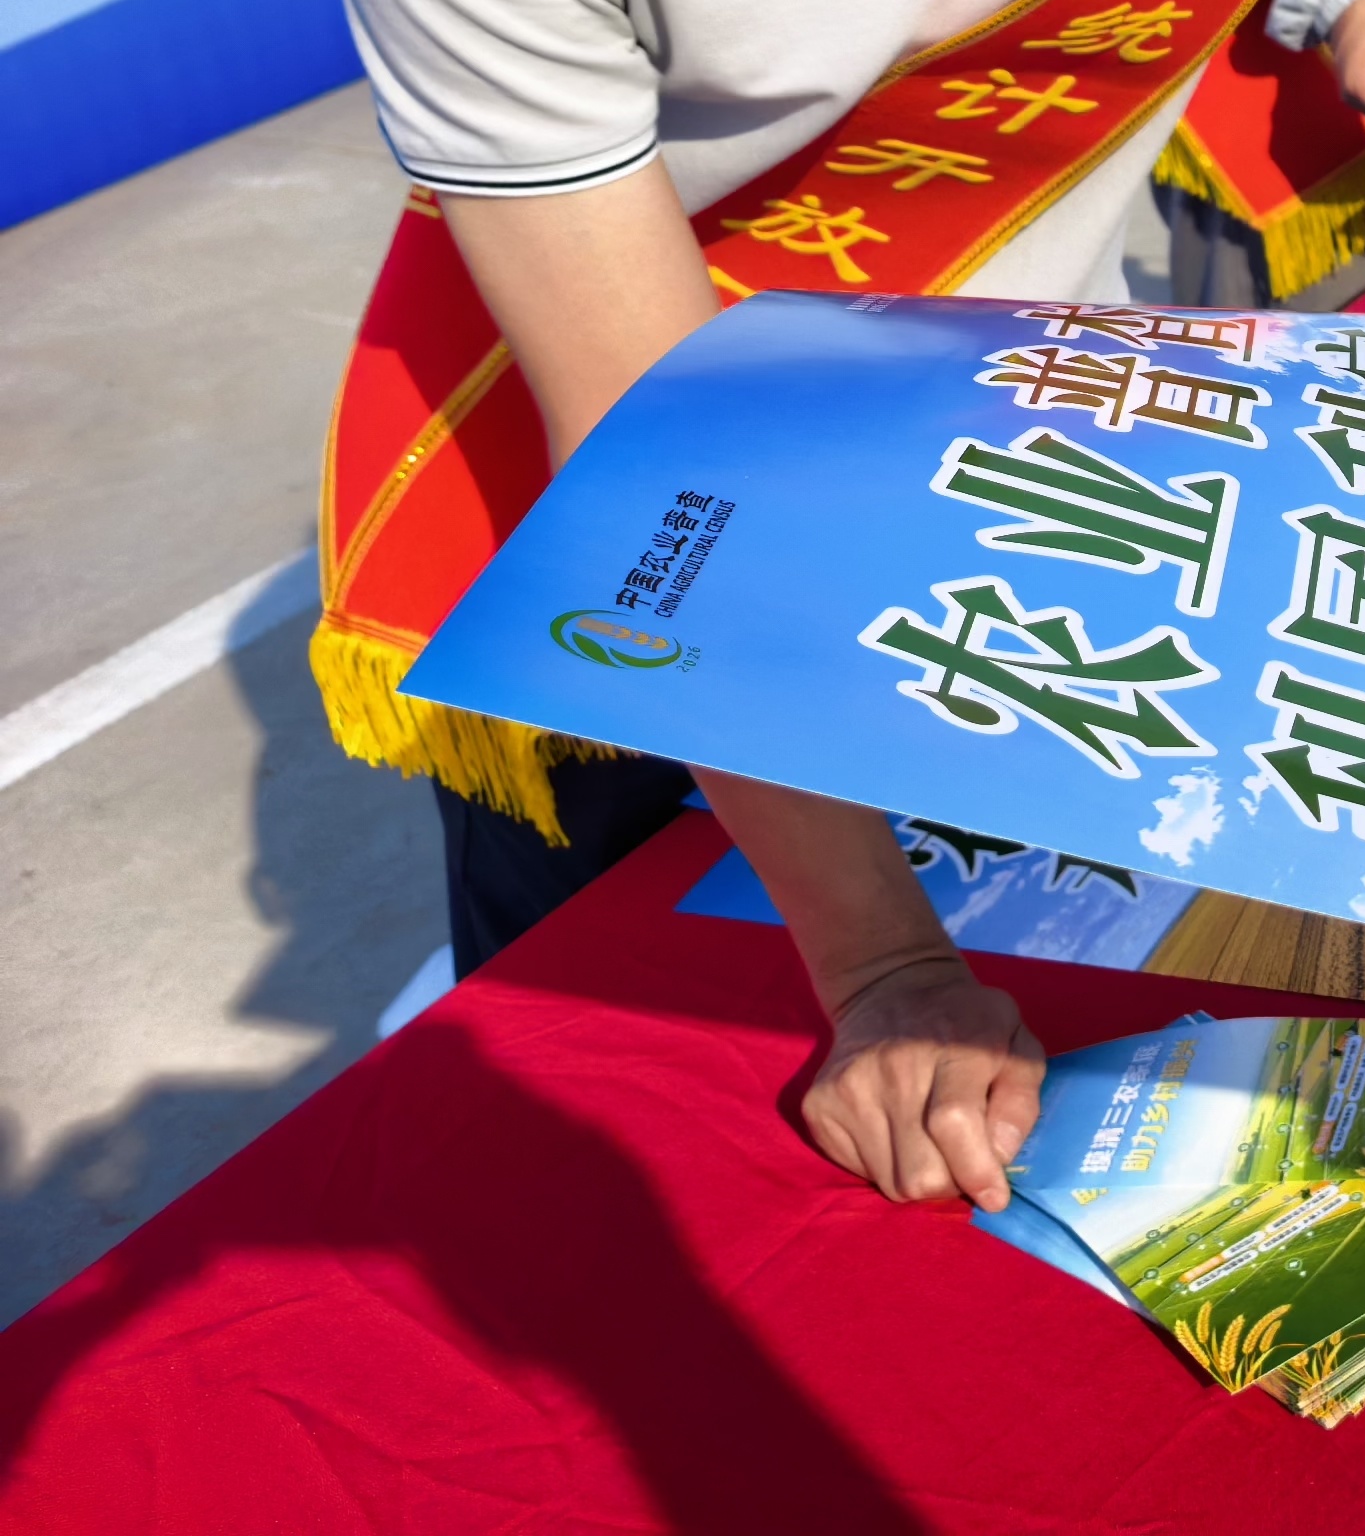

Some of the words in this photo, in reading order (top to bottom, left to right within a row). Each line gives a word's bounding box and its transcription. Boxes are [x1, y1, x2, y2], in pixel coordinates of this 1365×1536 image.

[616, 491, 715, 609] 中国农业普查
[654, 592, 684, 618] CHINA
[670, 534, 718, 593] AGRICULTURAL
[705, 500, 736, 533] CENSUS
[862, 305, 1268, 772] 农业普查
[676, 646, 701, 673] 2026
[1080, 1041, 1163, 1173] 摸清三农家底
[1120, 1039, 1198, 1171] 助力乡村振兴
